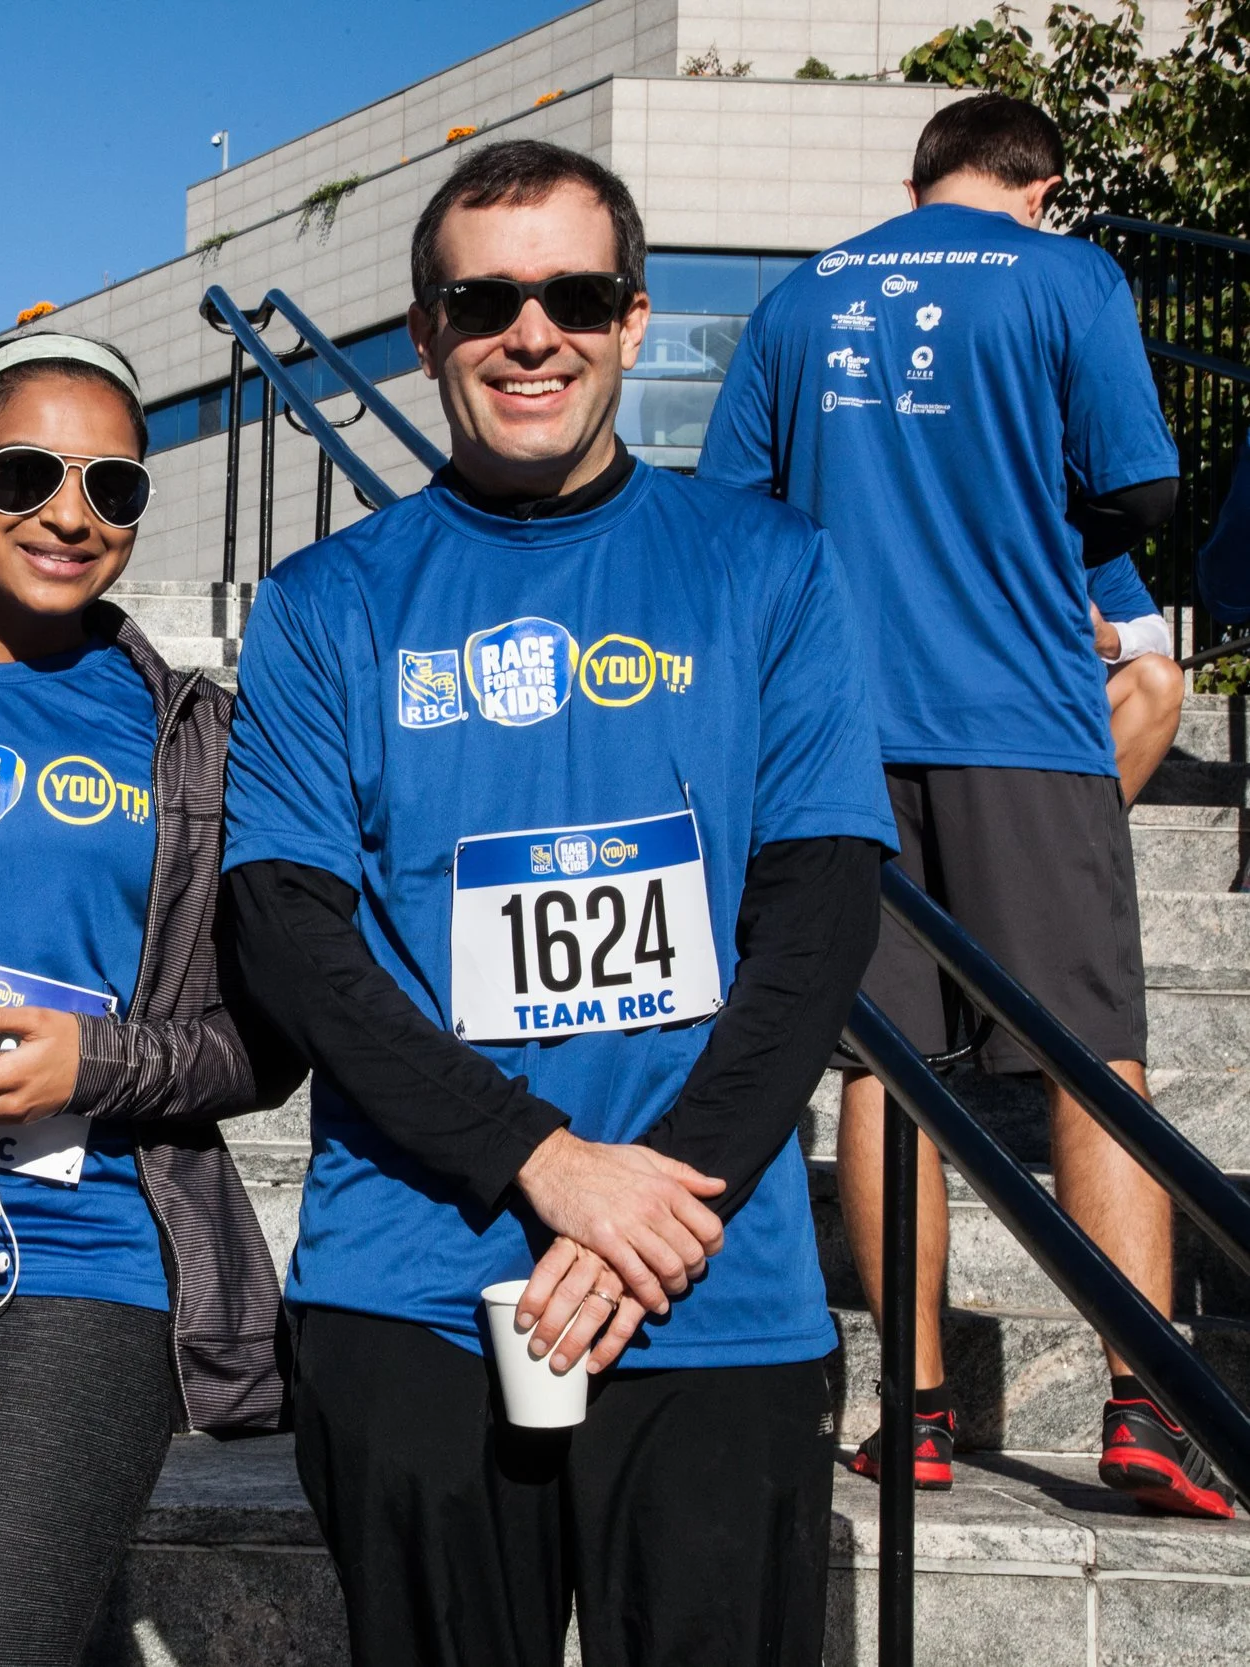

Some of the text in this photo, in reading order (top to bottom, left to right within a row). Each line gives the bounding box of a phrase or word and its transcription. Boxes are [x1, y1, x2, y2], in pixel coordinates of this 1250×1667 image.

[867, 253, 899, 265] CAN
[900, 252, 944, 264] RAISE
[946, 251, 977, 264] OUR
[981, 252, 1019, 266] CITY
[481, 636, 554, 675] RACE
[483, 666, 555, 692] FOR THE
[406, 702, 456, 724] RBC
[484, 685, 557, 718] KIDS
[560, 842, 587, 856] RACE
[534, 864, 550, 872] RBC
[561, 860, 589, 872] KIDS
[501, 878, 676, 995] 1624
[514, 989, 676, 1030] TEAM RBC
